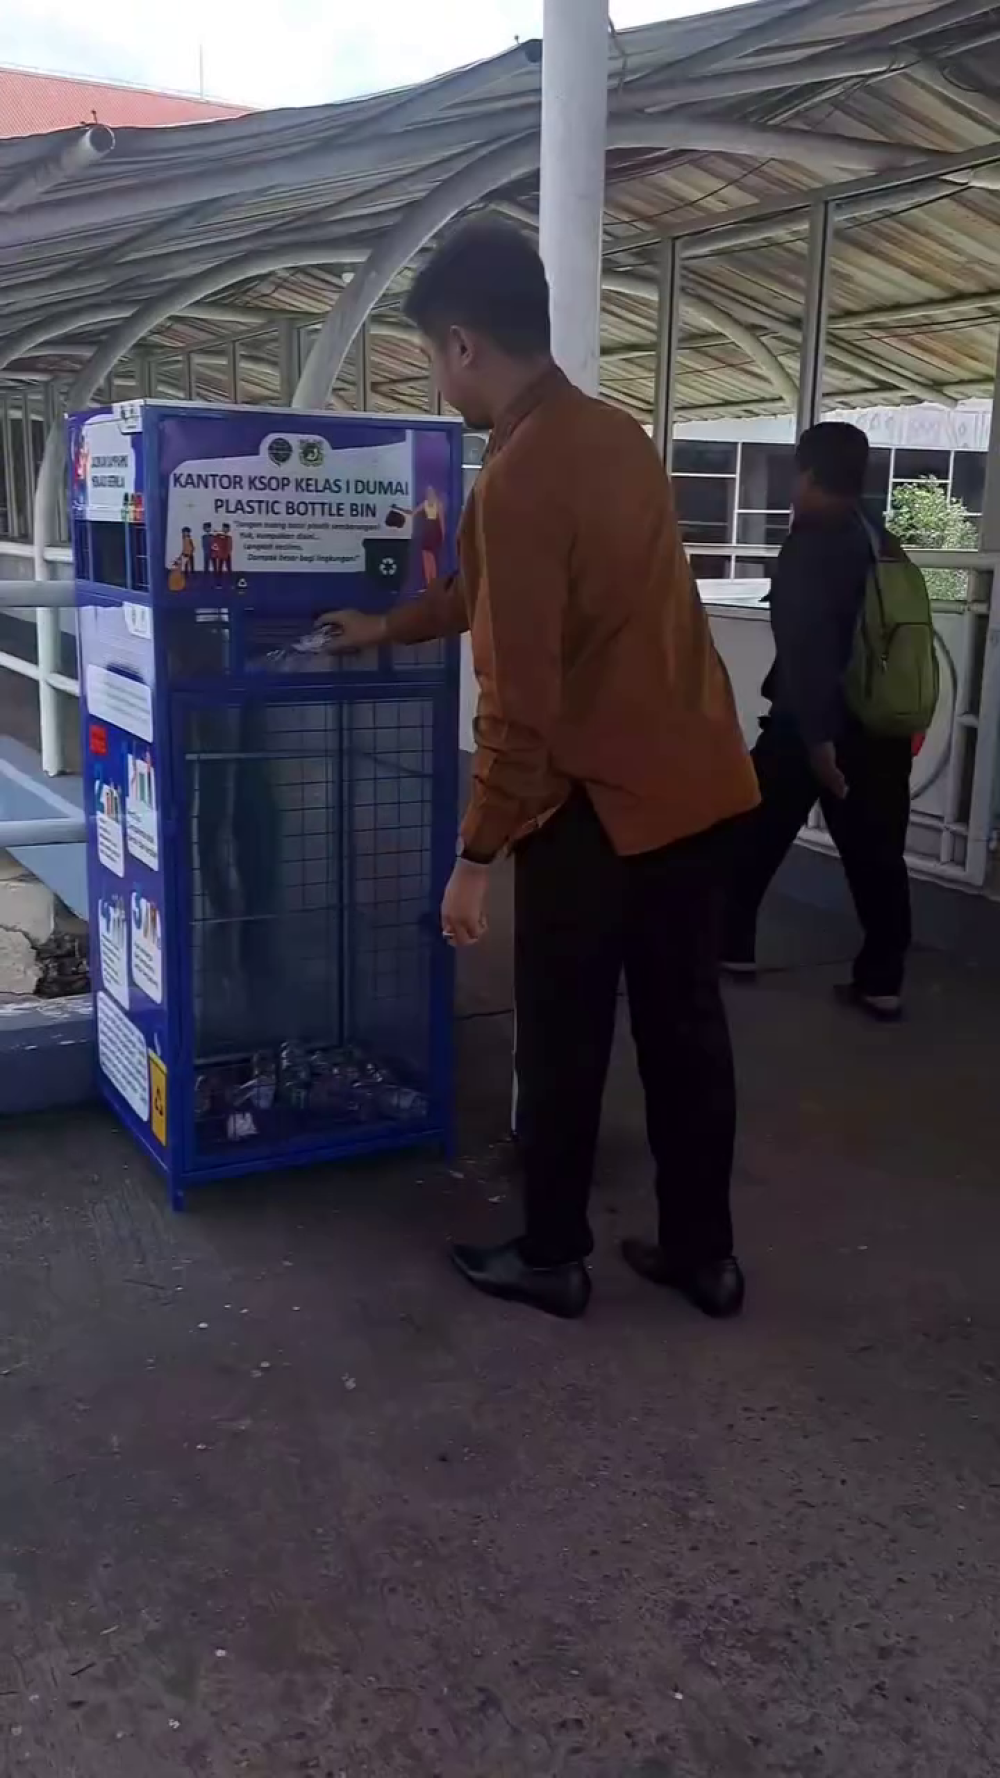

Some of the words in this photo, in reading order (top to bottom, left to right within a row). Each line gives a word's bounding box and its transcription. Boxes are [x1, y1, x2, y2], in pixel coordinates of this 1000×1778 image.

[172, 473, 243, 490] KANTOR
[248, 475, 290, 492] KSOP
[295, 477, 342, 494] KELAS
[346, 480, 351, 494] I
[354, 481, 409, 496] DUMAI
[214, 498, 282, 515] PLASTIC
[286, 501, 345, 517] BOTTLE
[349, 503, 377, 517] BIN
